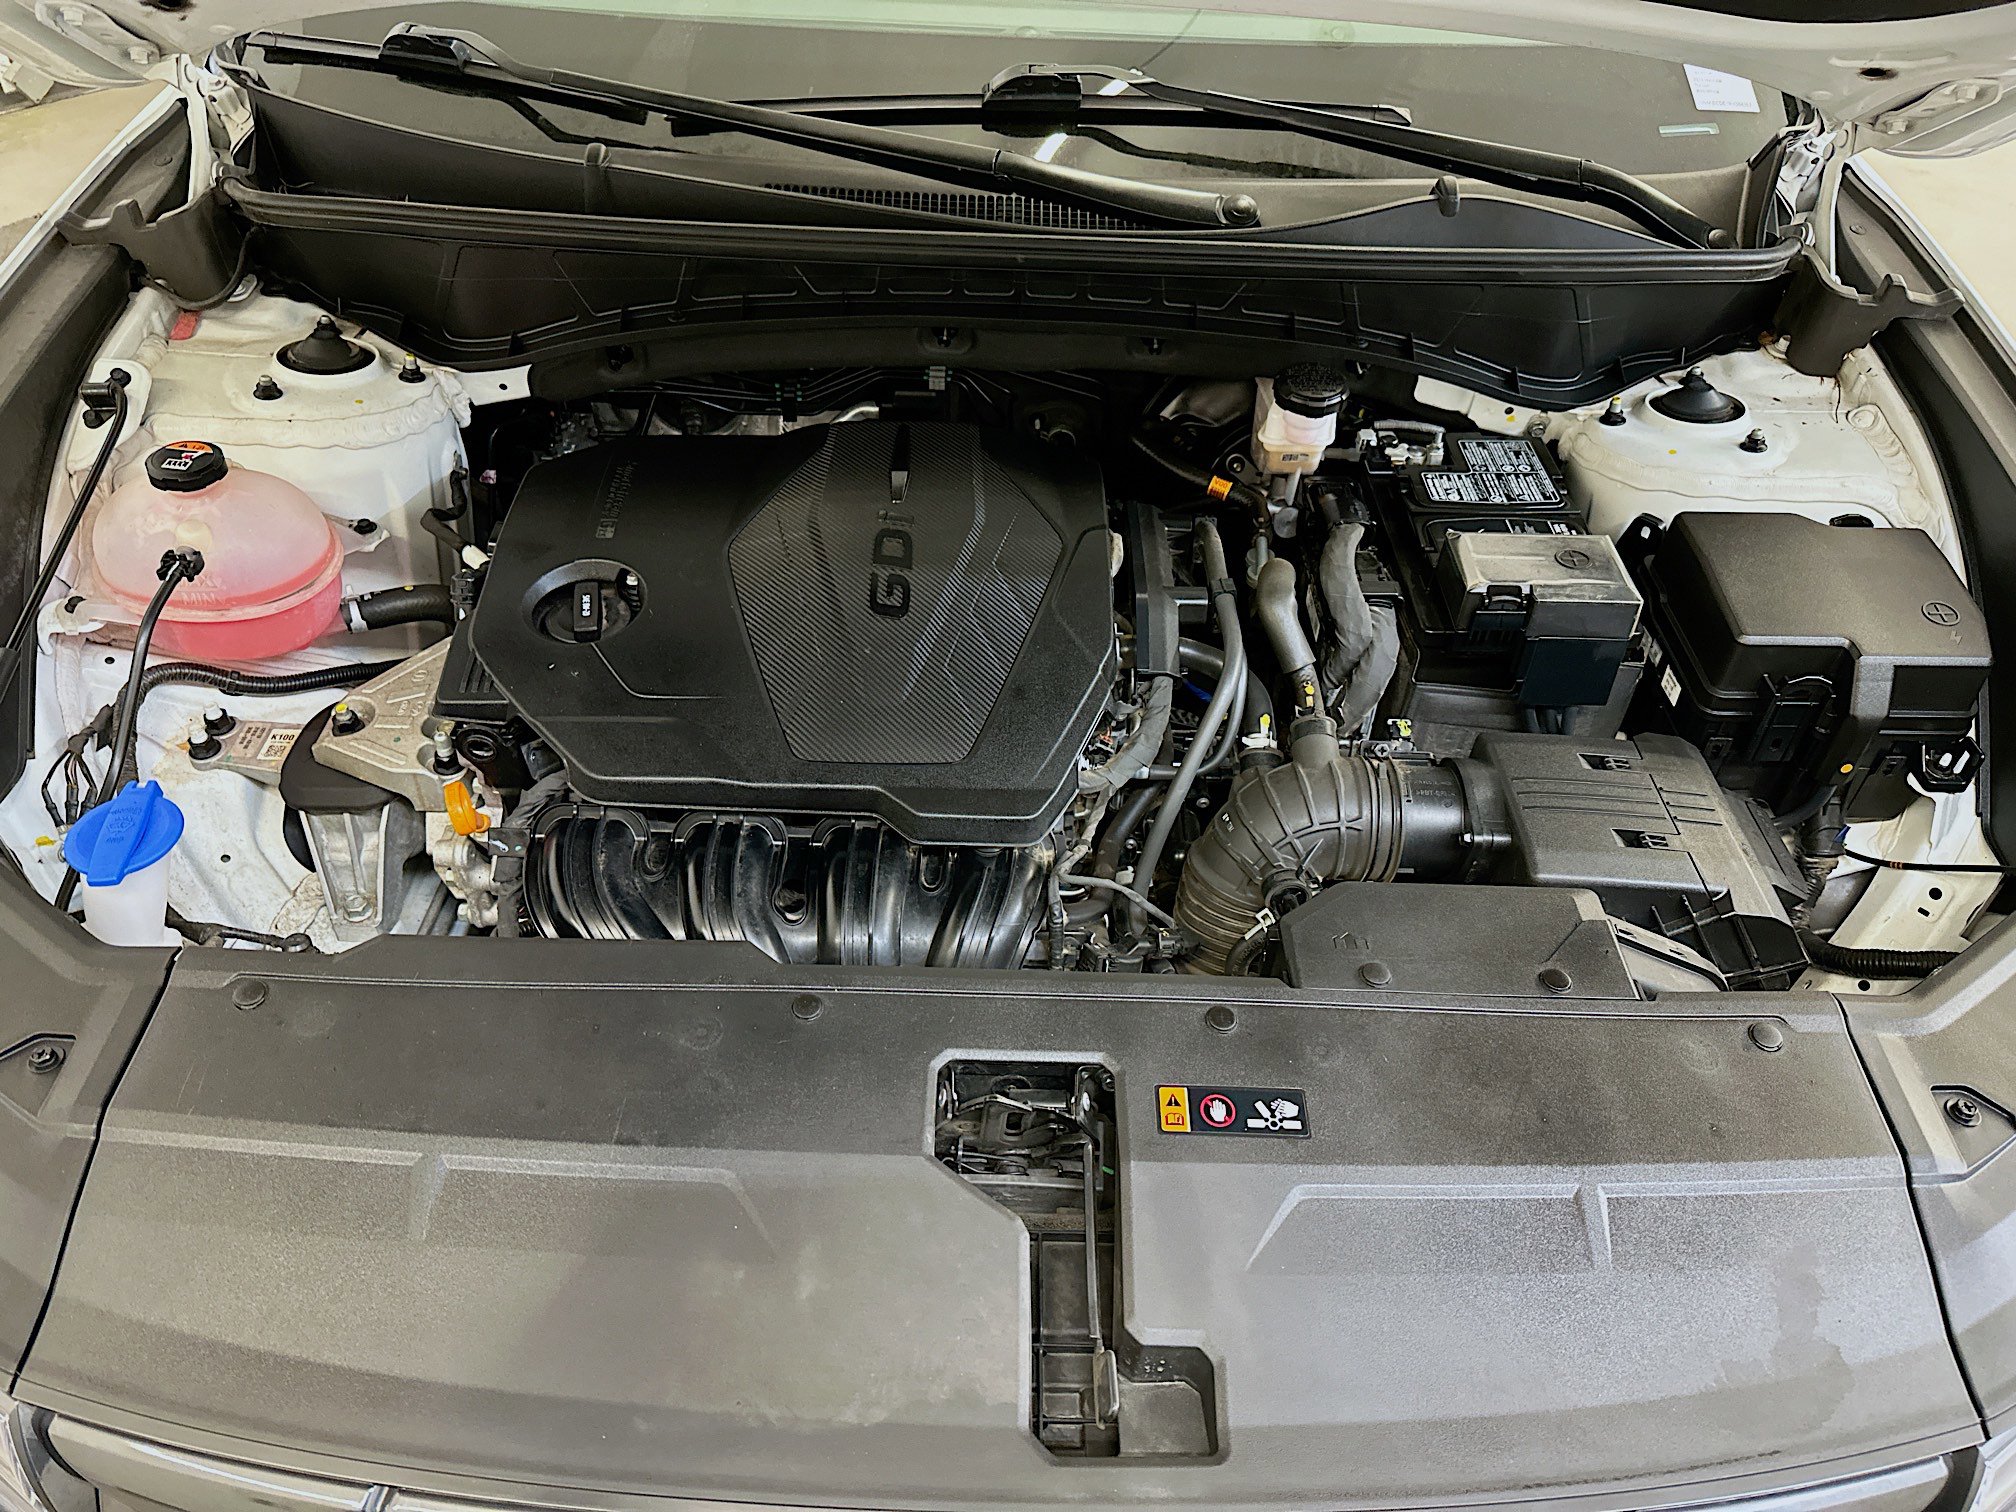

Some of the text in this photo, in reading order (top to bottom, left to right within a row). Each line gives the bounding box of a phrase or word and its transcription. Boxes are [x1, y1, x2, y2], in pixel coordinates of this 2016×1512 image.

[869, 509, 915, 619] GDi
[181, 591, 216, 606] MIN
[270, 733, 295, 741] K100
